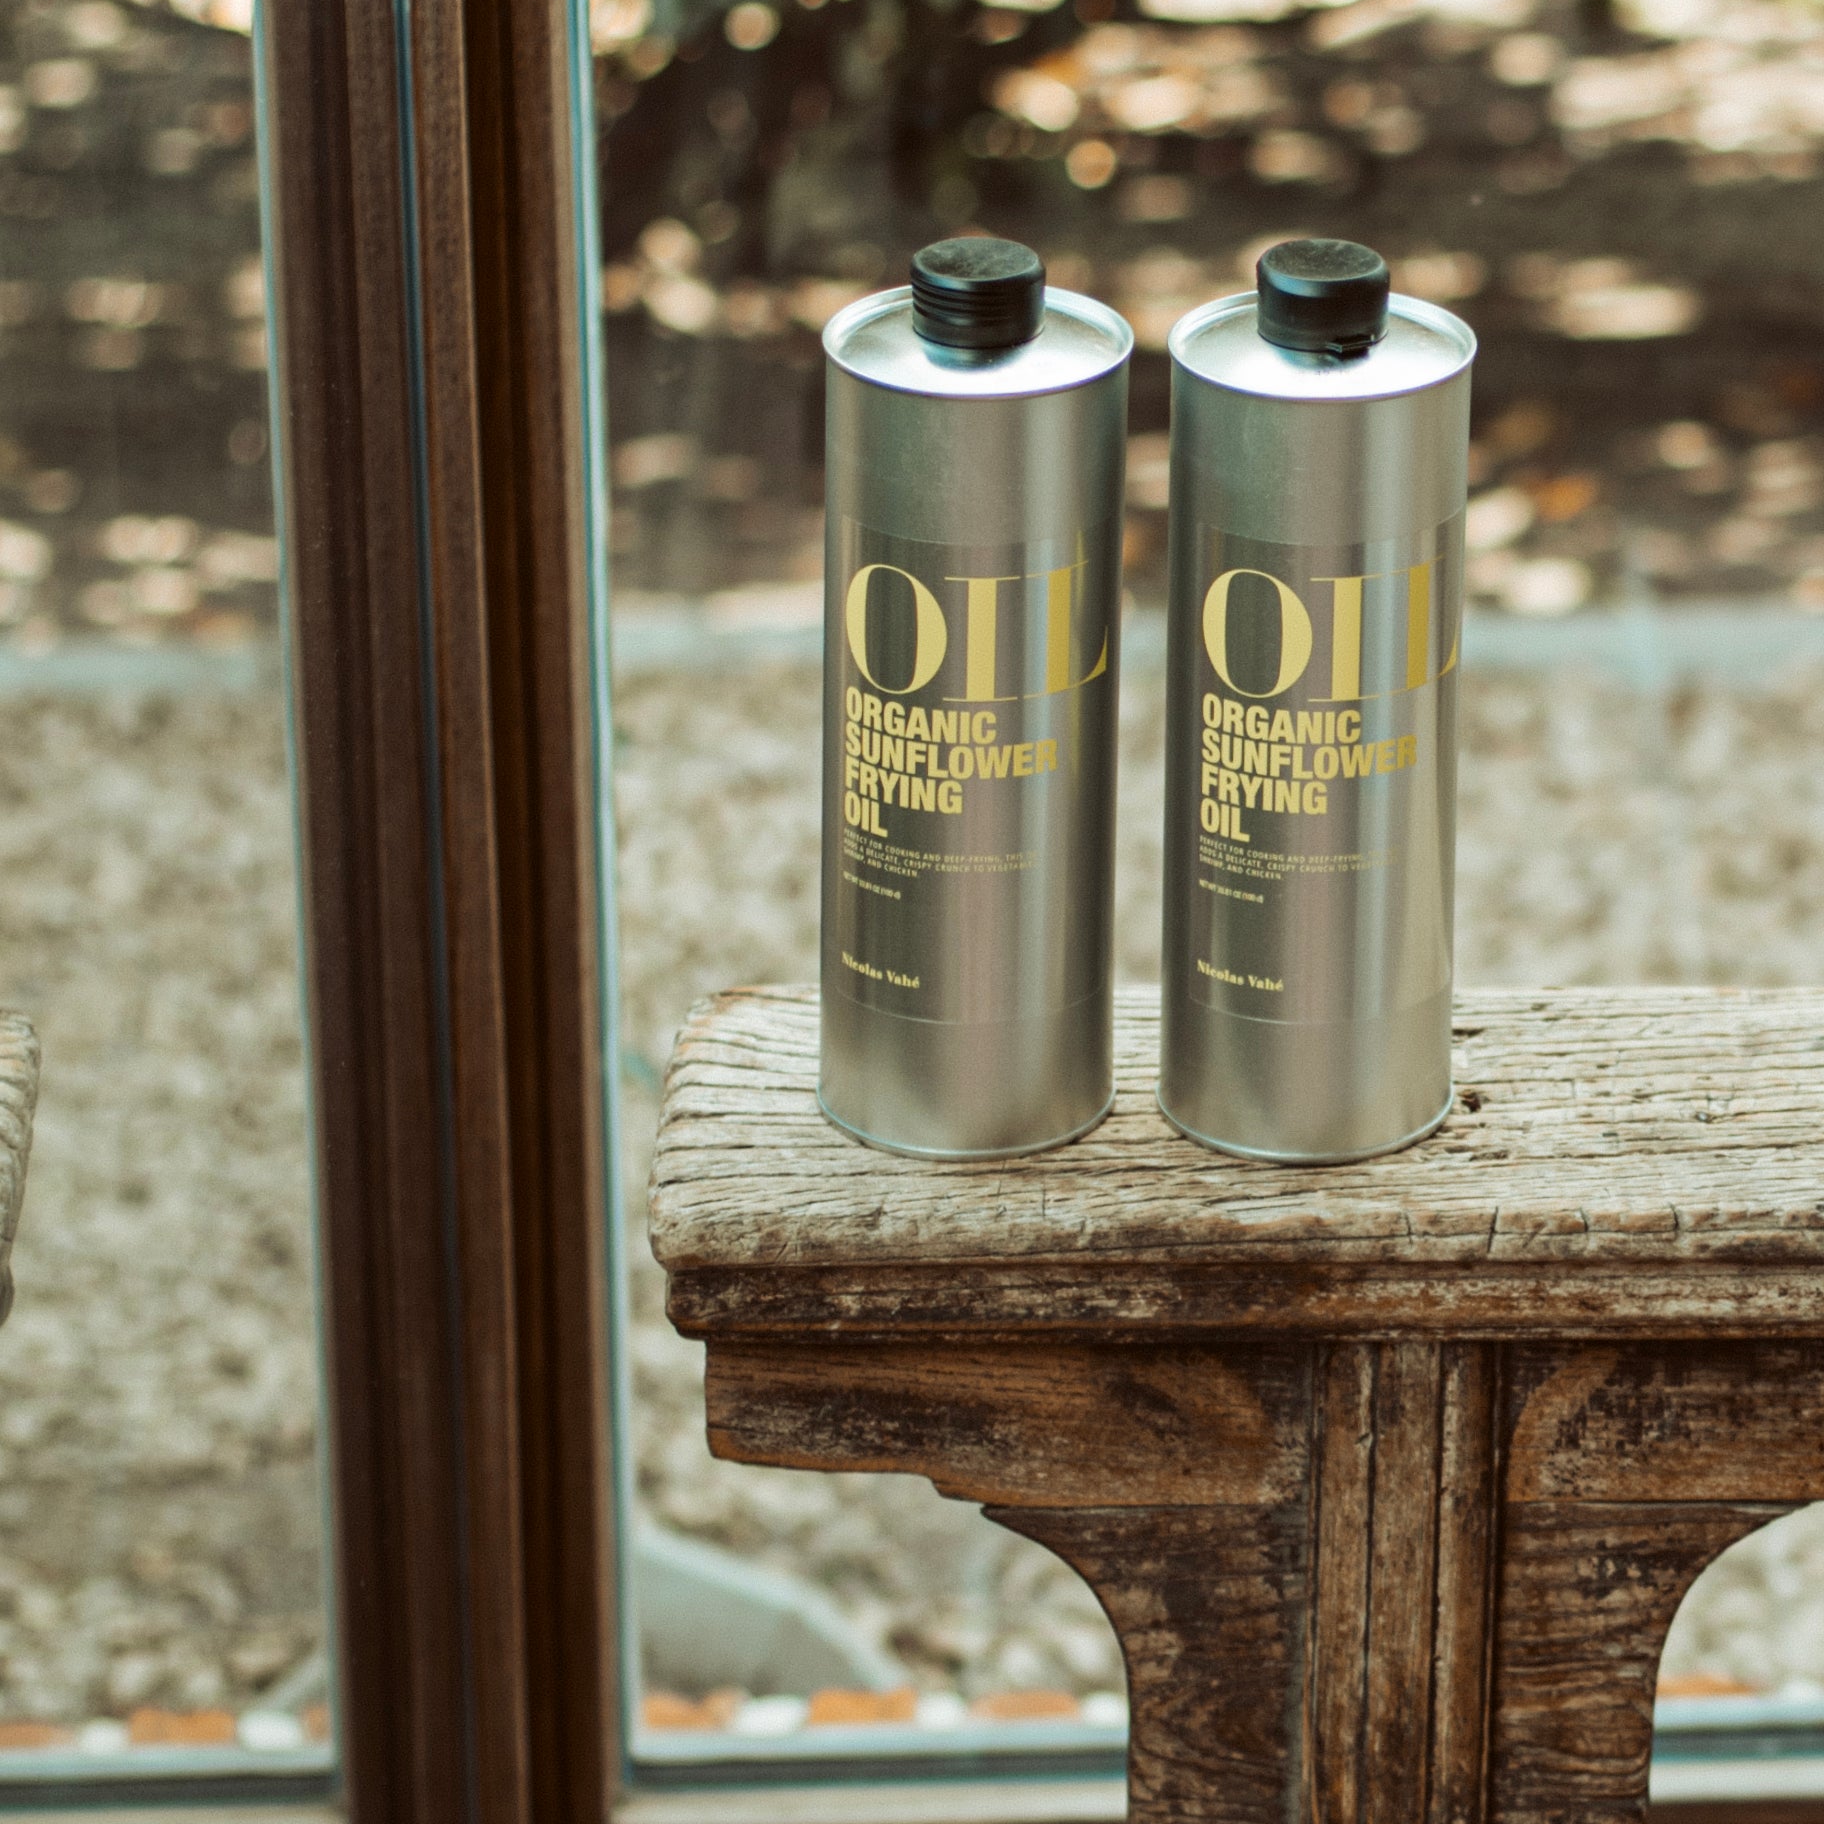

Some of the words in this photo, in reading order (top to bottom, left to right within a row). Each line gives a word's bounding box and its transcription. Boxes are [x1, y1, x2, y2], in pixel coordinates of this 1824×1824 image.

[846, 559, 1108, 702] OIL
[1203, 555, 1458, 702] OIL
[846, 686, 997, 744] ORGANIC
[1203, 693, 1361, 744] ORGANIC
[845, 721, 1058, 780] SUNFLOWER
[1202, 728, 1417, 780] SUNFLOWER
[845, 755, 963, 814] FRYING
[1202, 762, 1328, 815] FRYING
[844, 791, 888, 837] OIL
[1200, 797, 1250, 842] OIL
[885, 845, 920, 860] COOKING
[923, 853, 941, 862] AND
[904, 859, 931, 869] CRISPY
[973, 864, 985, 873] TO
[1200, 835, 1227, 851] PERFECT
[1229, 845, 1244, 855] FOR
[1247, 850, 1284, 862] COOKING
[1287, 856, 1305, 864] AND
[1227, 864, 1244, 874] AND
[1267, 862, 1296, 872] CRISPY
[842, 951, 883, 980] Nicolas
[886, 969, 920, 989] Vahé
[1197, 959, 1244, 986] Nicolas
[1248, 974, 1284, 992] Vahé
